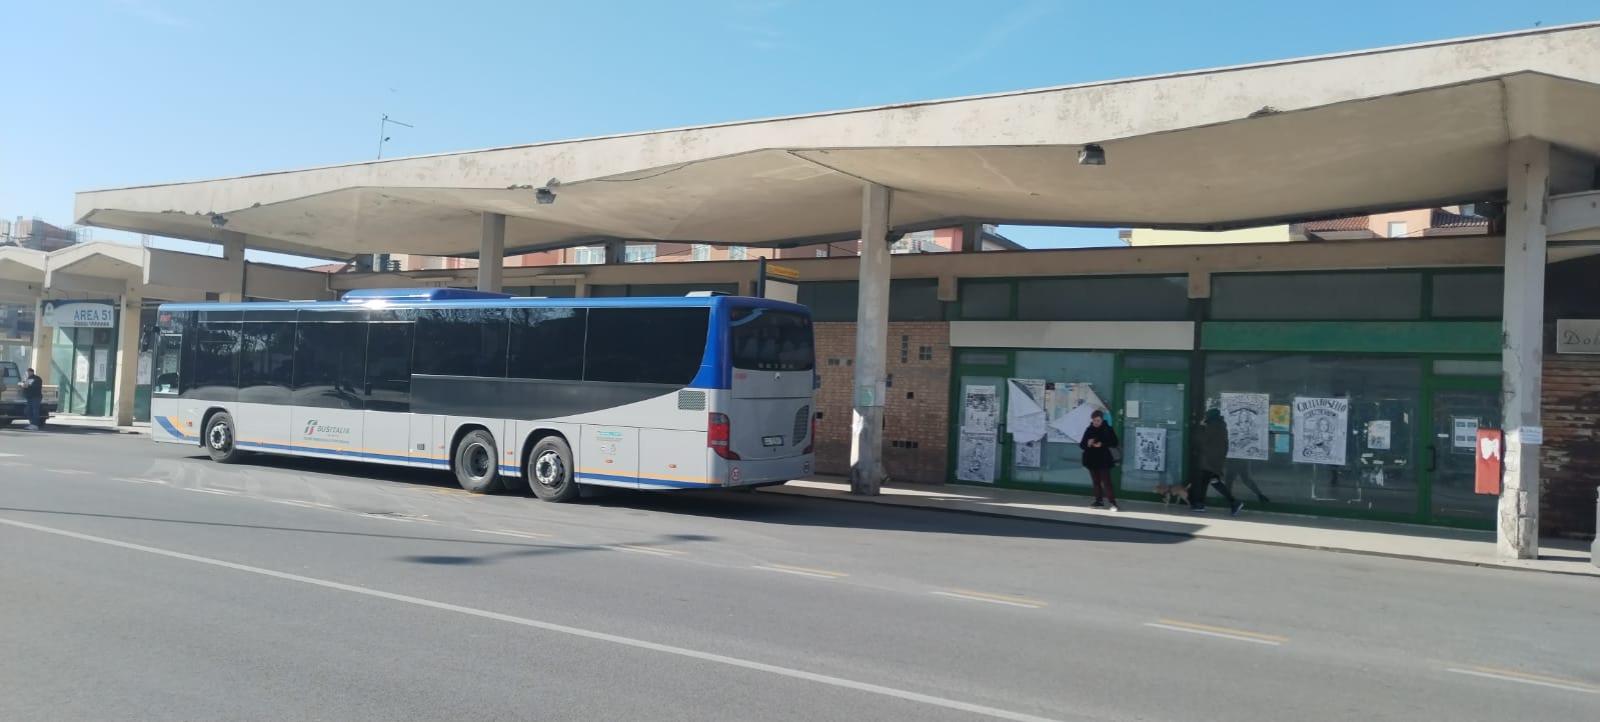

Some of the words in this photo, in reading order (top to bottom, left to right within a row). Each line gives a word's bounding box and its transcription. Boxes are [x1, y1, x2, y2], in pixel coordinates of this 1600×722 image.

[73, 310, 99, 321] AREA
[101, 310, 112, 321] 51
[317, 425, 351, 434] BUSITALIA
